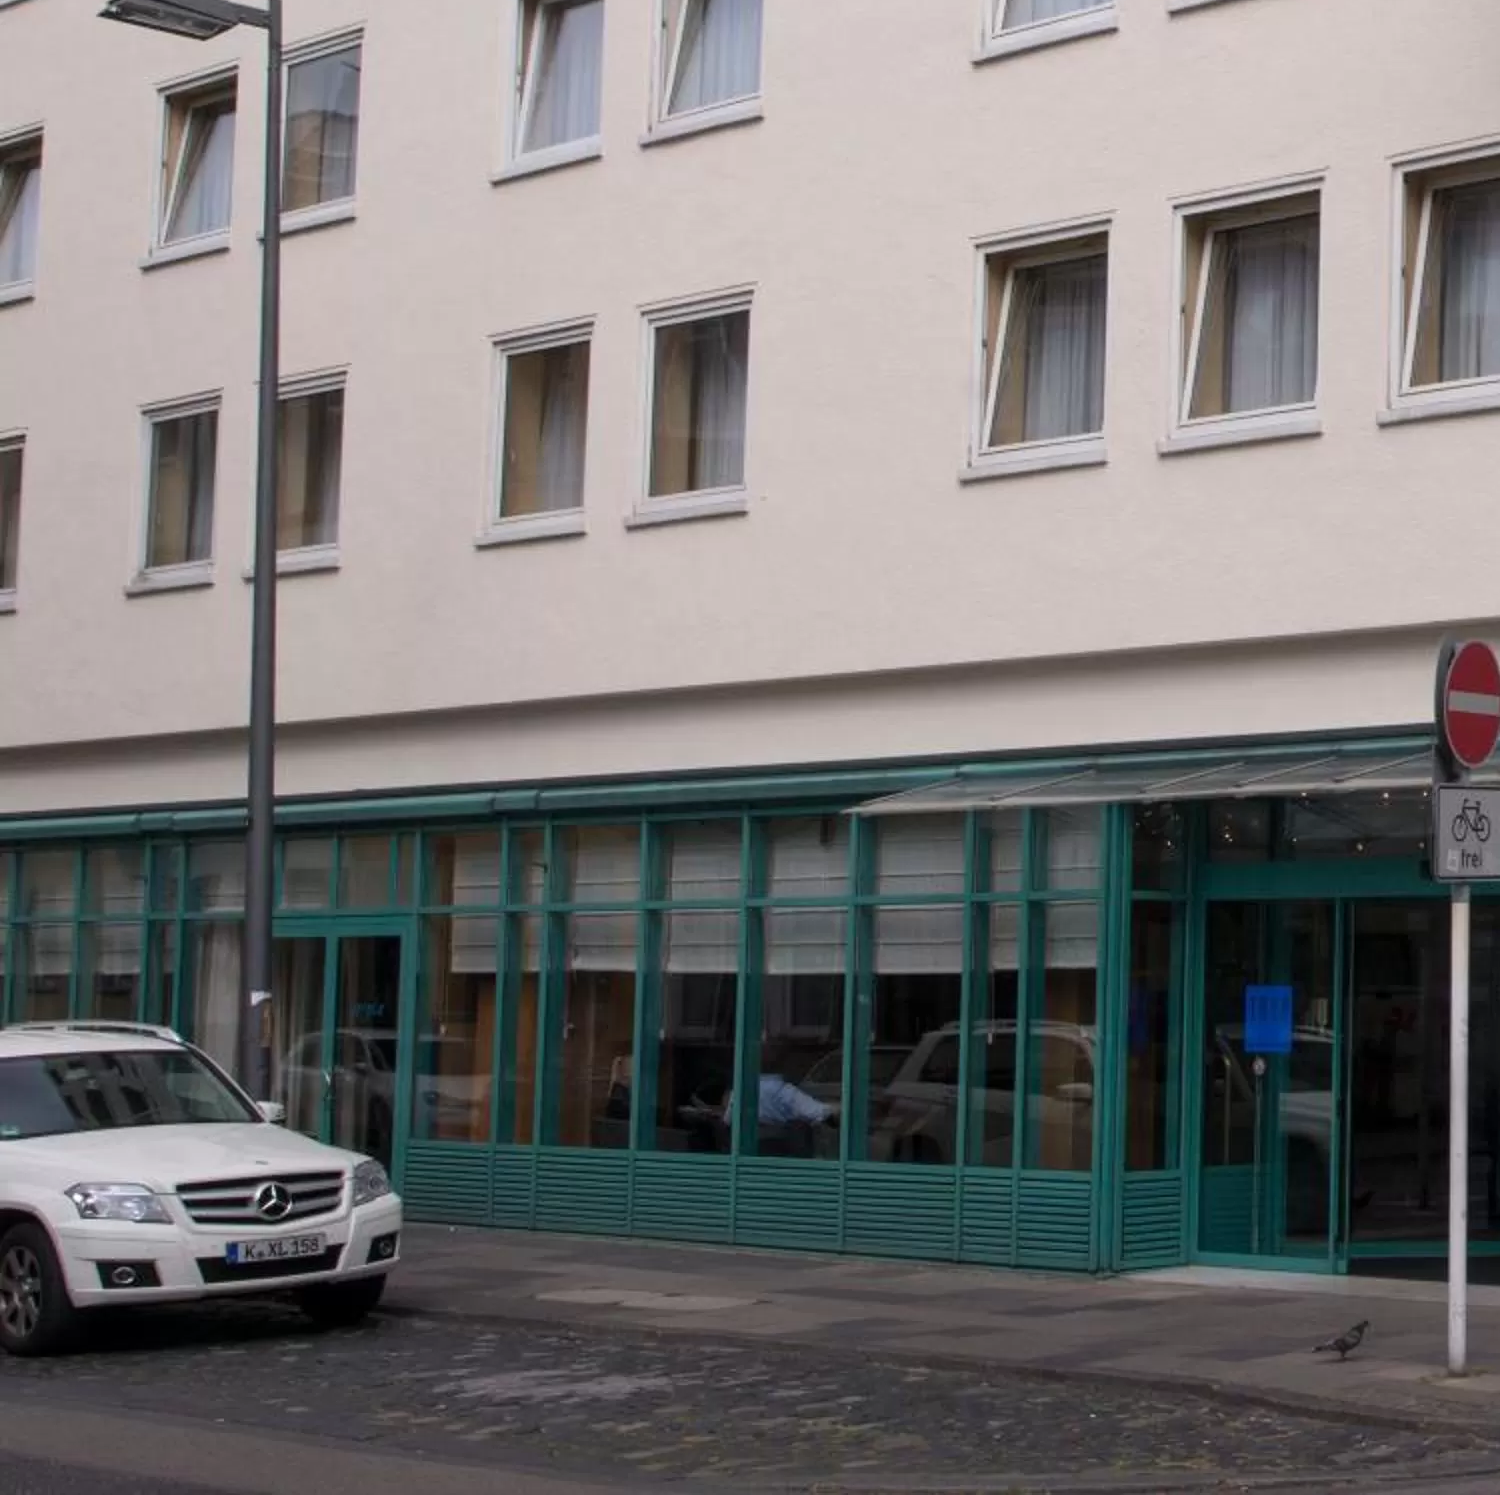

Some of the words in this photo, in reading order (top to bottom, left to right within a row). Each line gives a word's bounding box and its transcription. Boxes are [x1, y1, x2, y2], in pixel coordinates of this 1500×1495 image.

[1461, 847, 1483, 869] frei
[245, 1243, 255, 1259] K
[268, 1240, 288, 1257] XL
